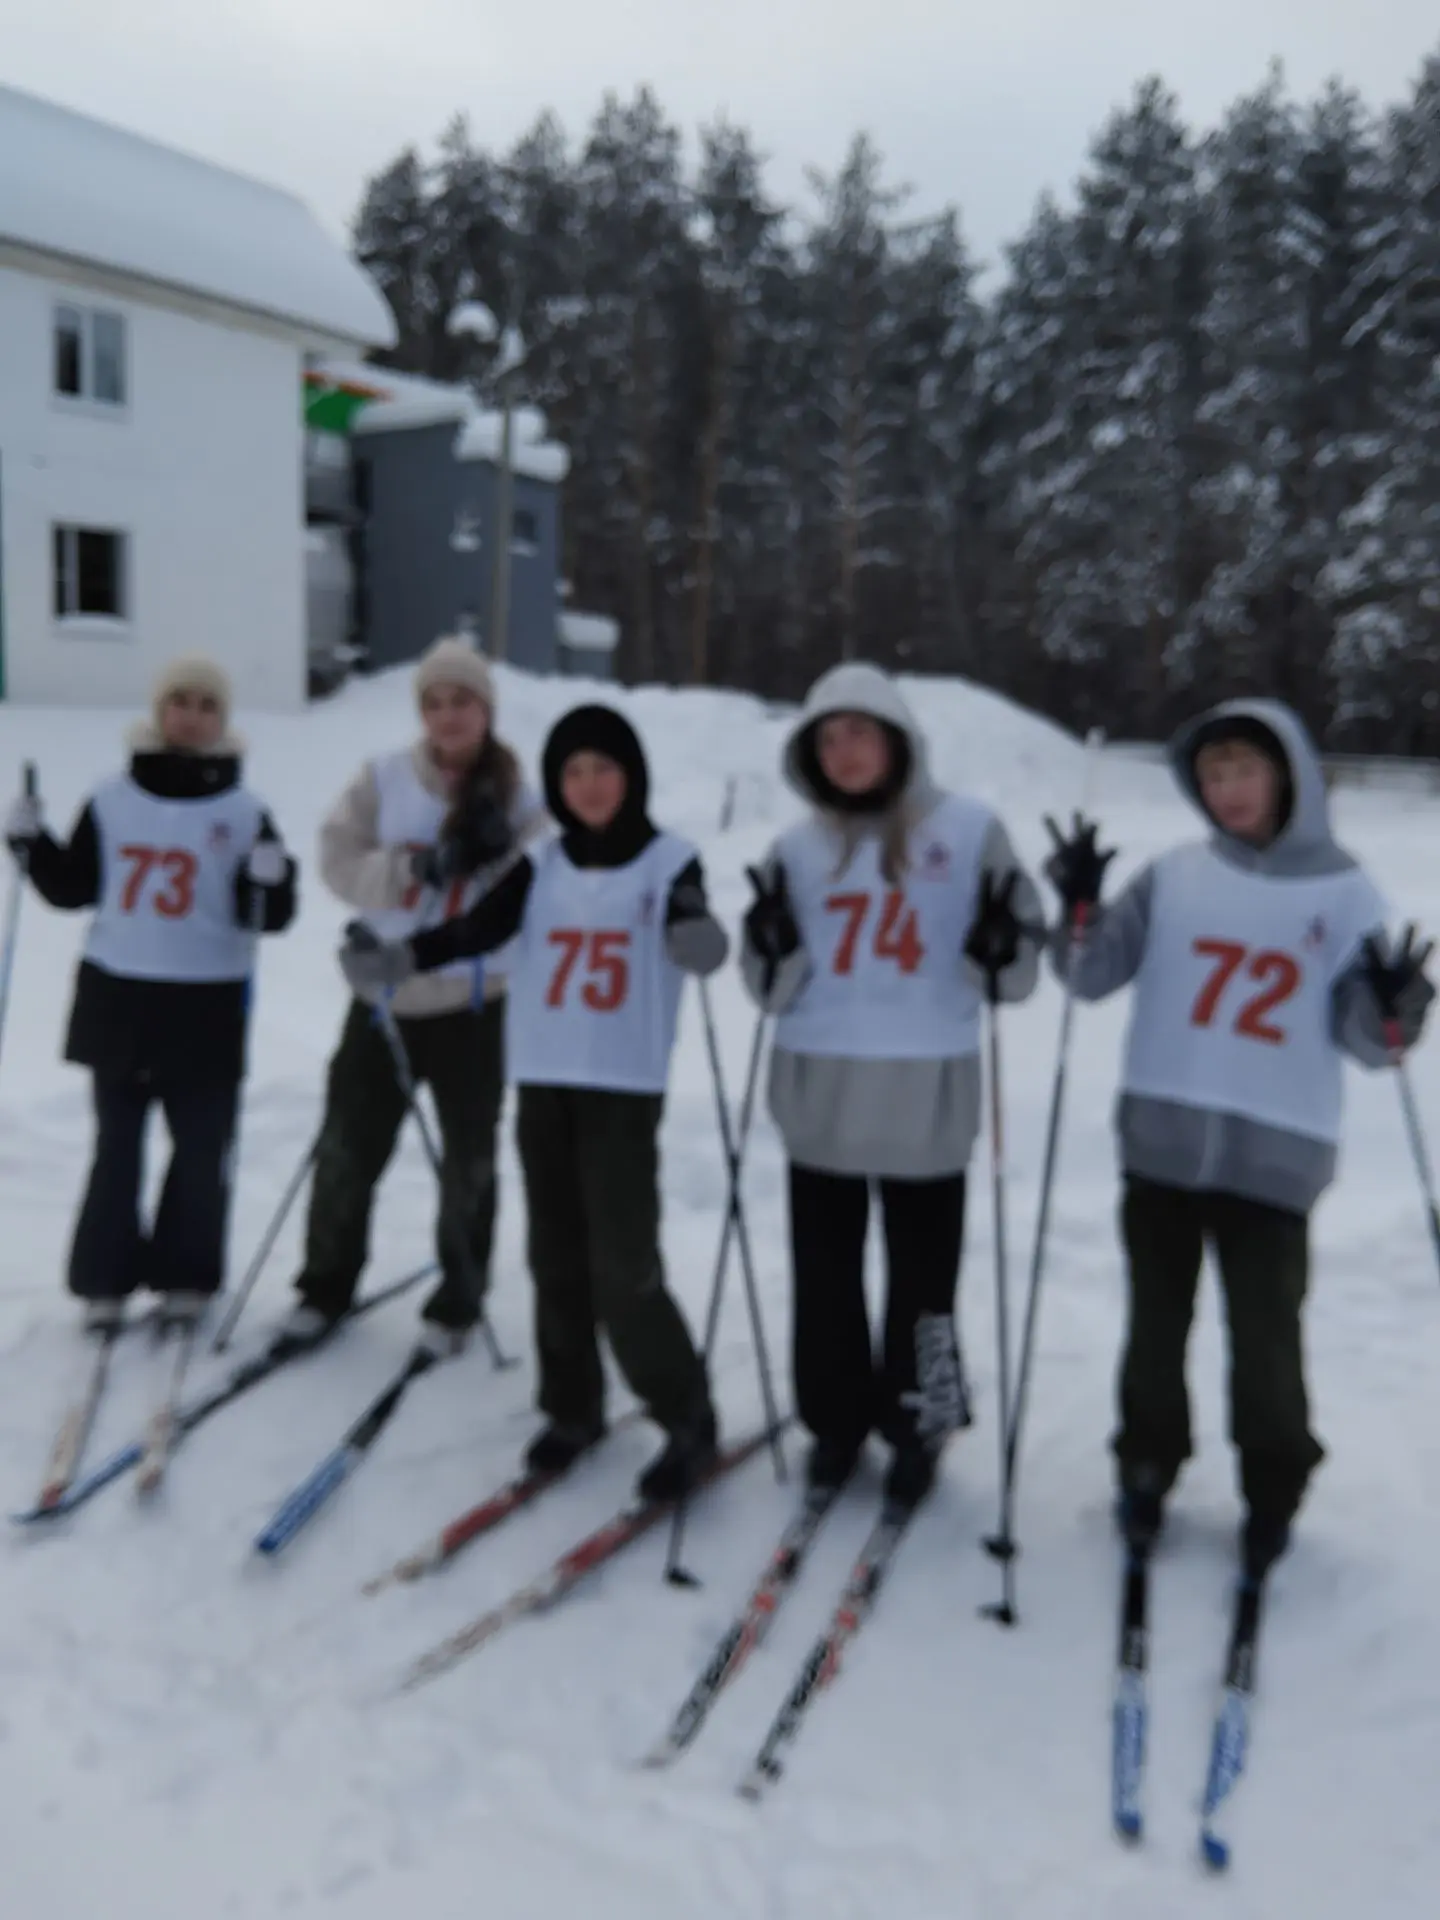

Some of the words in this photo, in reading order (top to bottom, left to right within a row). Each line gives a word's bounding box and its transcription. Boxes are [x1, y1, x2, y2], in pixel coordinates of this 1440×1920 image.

[119, 846, 198, 916] 73
[546, 931, 629, 1011] 75
[826, 889, 924, 975] 74
[1192, 939, 1301, 1044] 72
